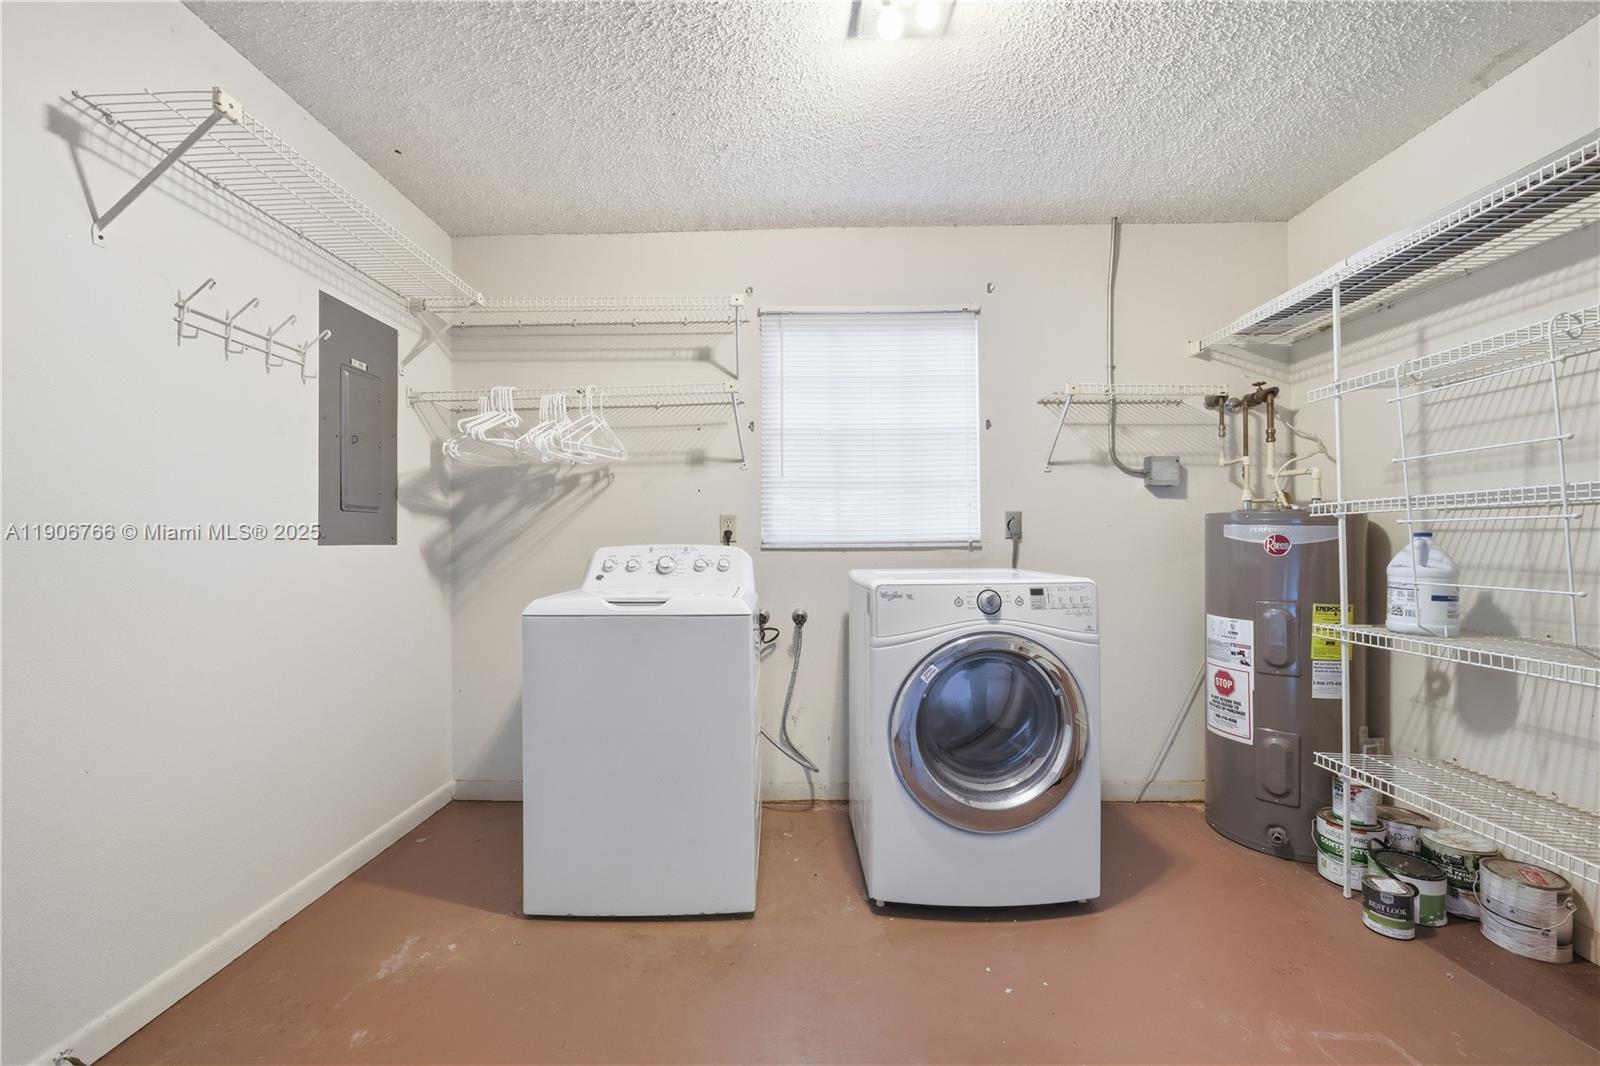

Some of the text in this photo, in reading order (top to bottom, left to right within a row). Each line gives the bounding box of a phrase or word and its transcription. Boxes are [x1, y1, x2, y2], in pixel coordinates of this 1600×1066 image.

[1216, 677, 1233, 689] STOP
[1353, 837, 1369, 845] PRO
[1387, 905, 1408, 916] LOOK
